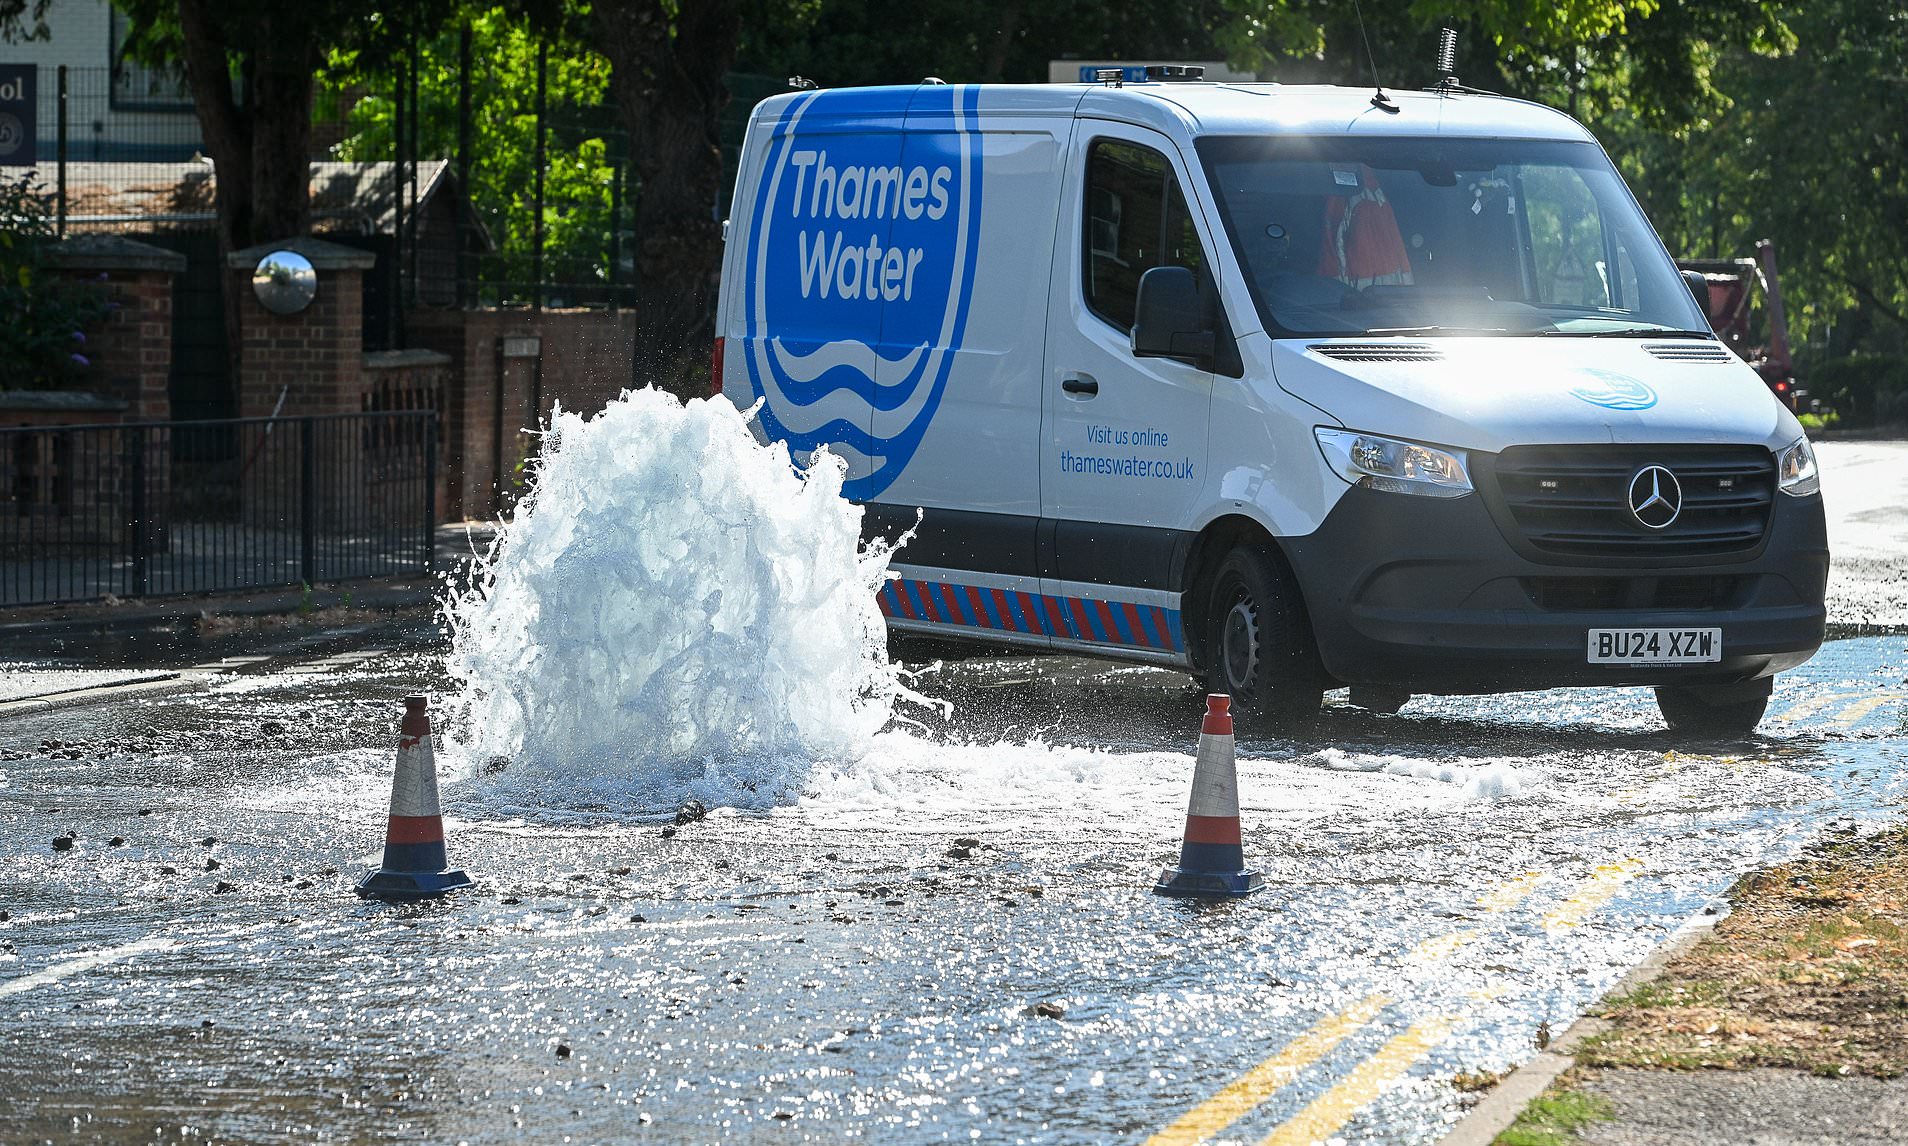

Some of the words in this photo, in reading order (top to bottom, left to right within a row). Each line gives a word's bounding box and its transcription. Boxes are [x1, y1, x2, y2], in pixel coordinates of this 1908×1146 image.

[791, 150, 952, 220] Thames
[798, 230, 924, 301] Water
[1087, 425, 1112, 444] Visit
[1115, 431, 1128, 445] us
[1132, 427, 1168, 447] online
[1061, 450, 1194, 479] thameswater.co.uk
[1598, 632, 1661, 658] BU24
[1668, 631, 1713, 657] XZW
